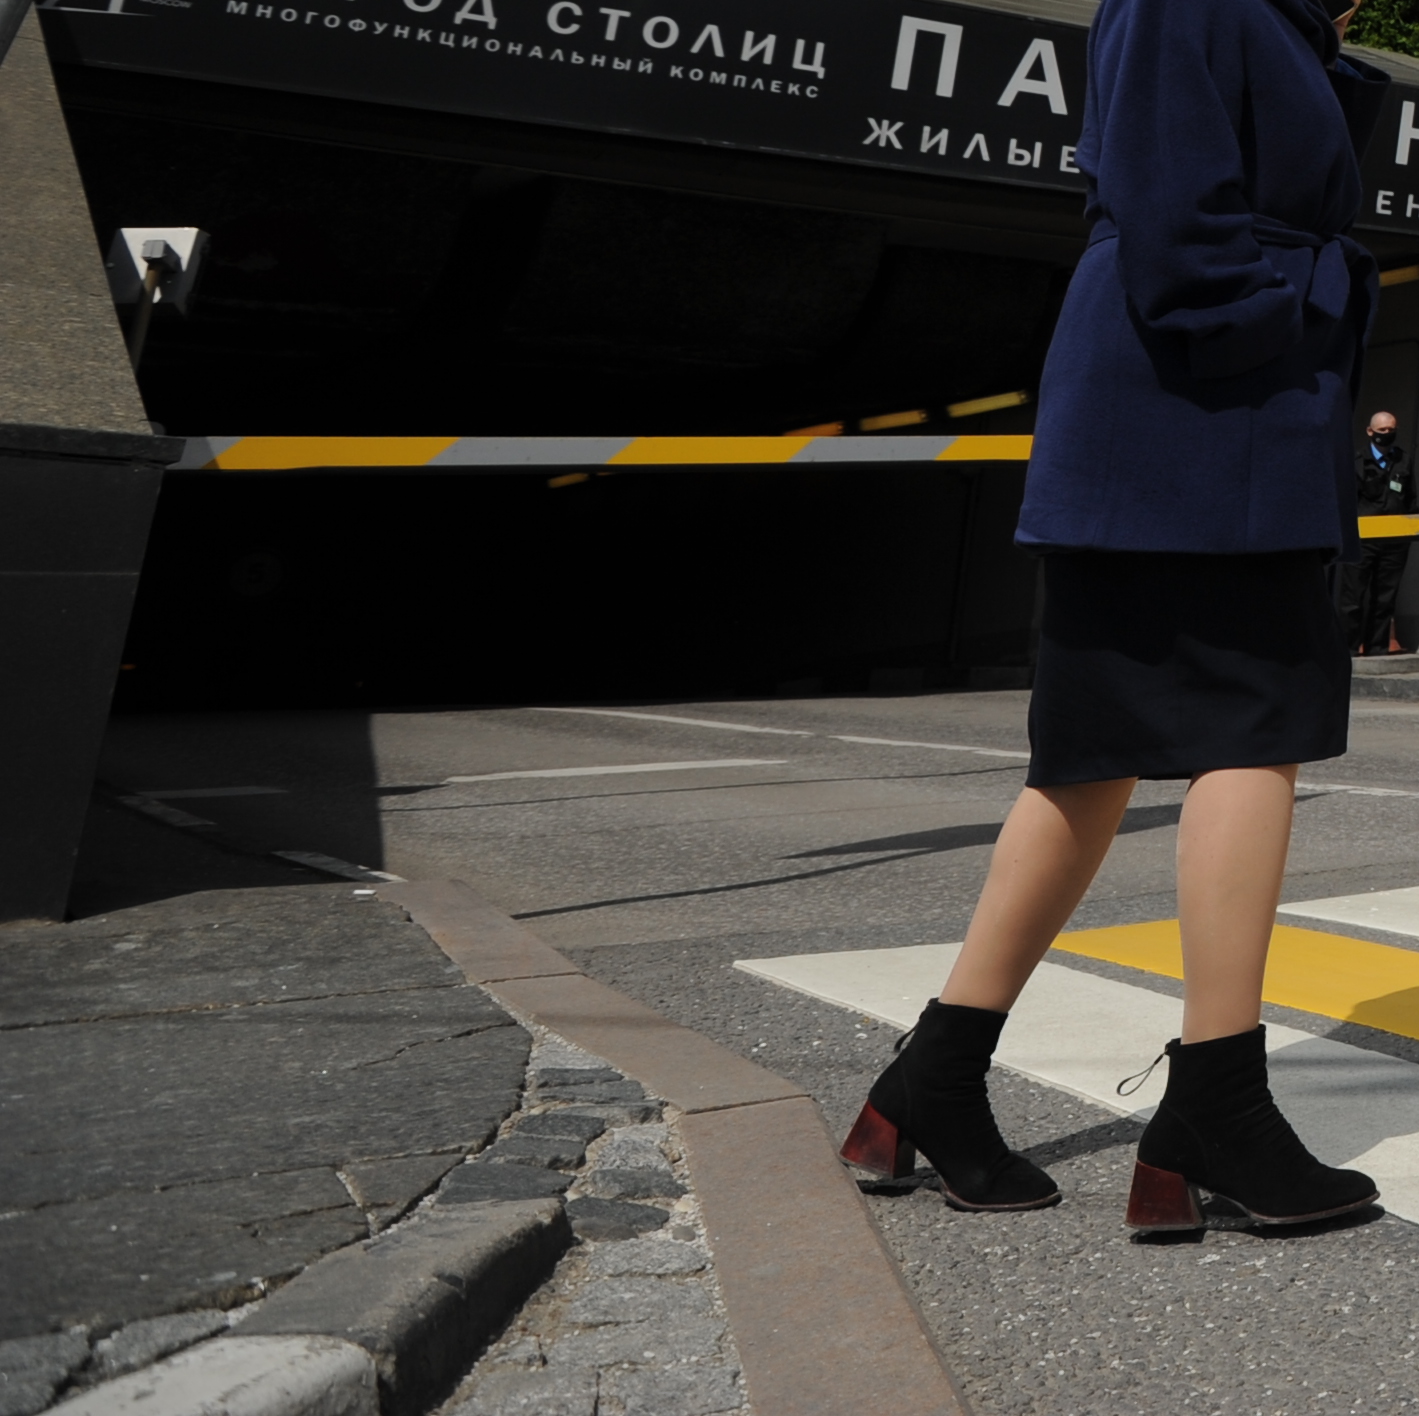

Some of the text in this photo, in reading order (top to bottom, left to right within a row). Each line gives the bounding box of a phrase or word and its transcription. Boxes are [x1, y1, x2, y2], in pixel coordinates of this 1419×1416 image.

[226, 0, 820, 99] МНОГОФУНКЦИОНАЛЬНЫЙ КОМПЛЕКС
[546, 0, 827, 79] СТОЛИЦ
[862, 117, 1081, 174] ЖИЛЫЕ
